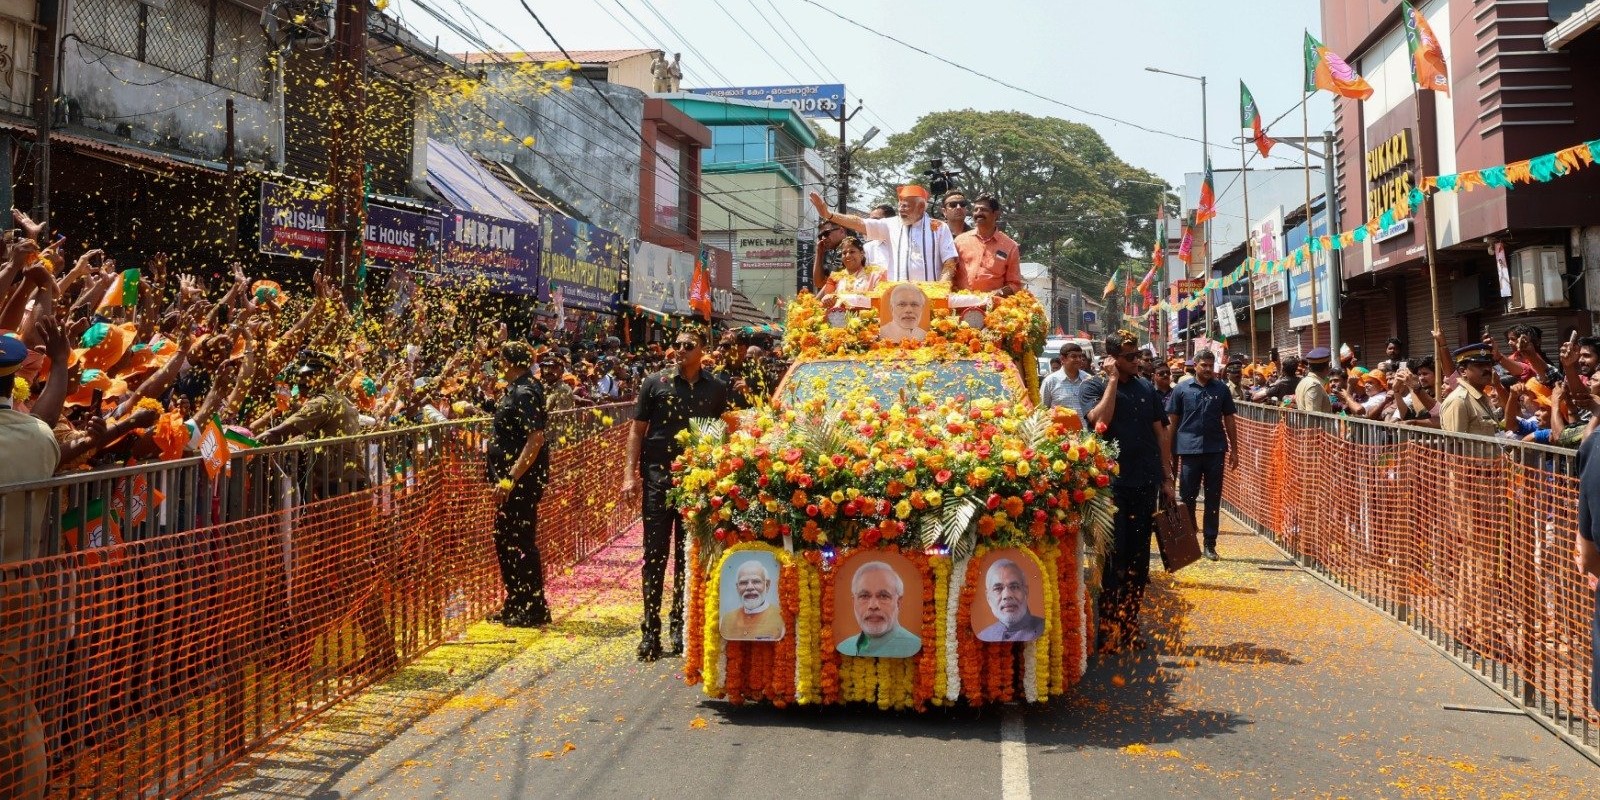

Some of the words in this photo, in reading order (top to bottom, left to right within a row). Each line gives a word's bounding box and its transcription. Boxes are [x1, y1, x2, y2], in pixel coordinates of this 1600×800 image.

[1367, 129, 1409, 182] SUKKRA
[1368, 171, 1411, 221] SILVERS
[271, 207, 326, 232] KRISHN
[380, 226, 416, 248] HOUSE
[740, 238, 765, 248] JEWEL
[766, 238, 795, 246] PALACE
